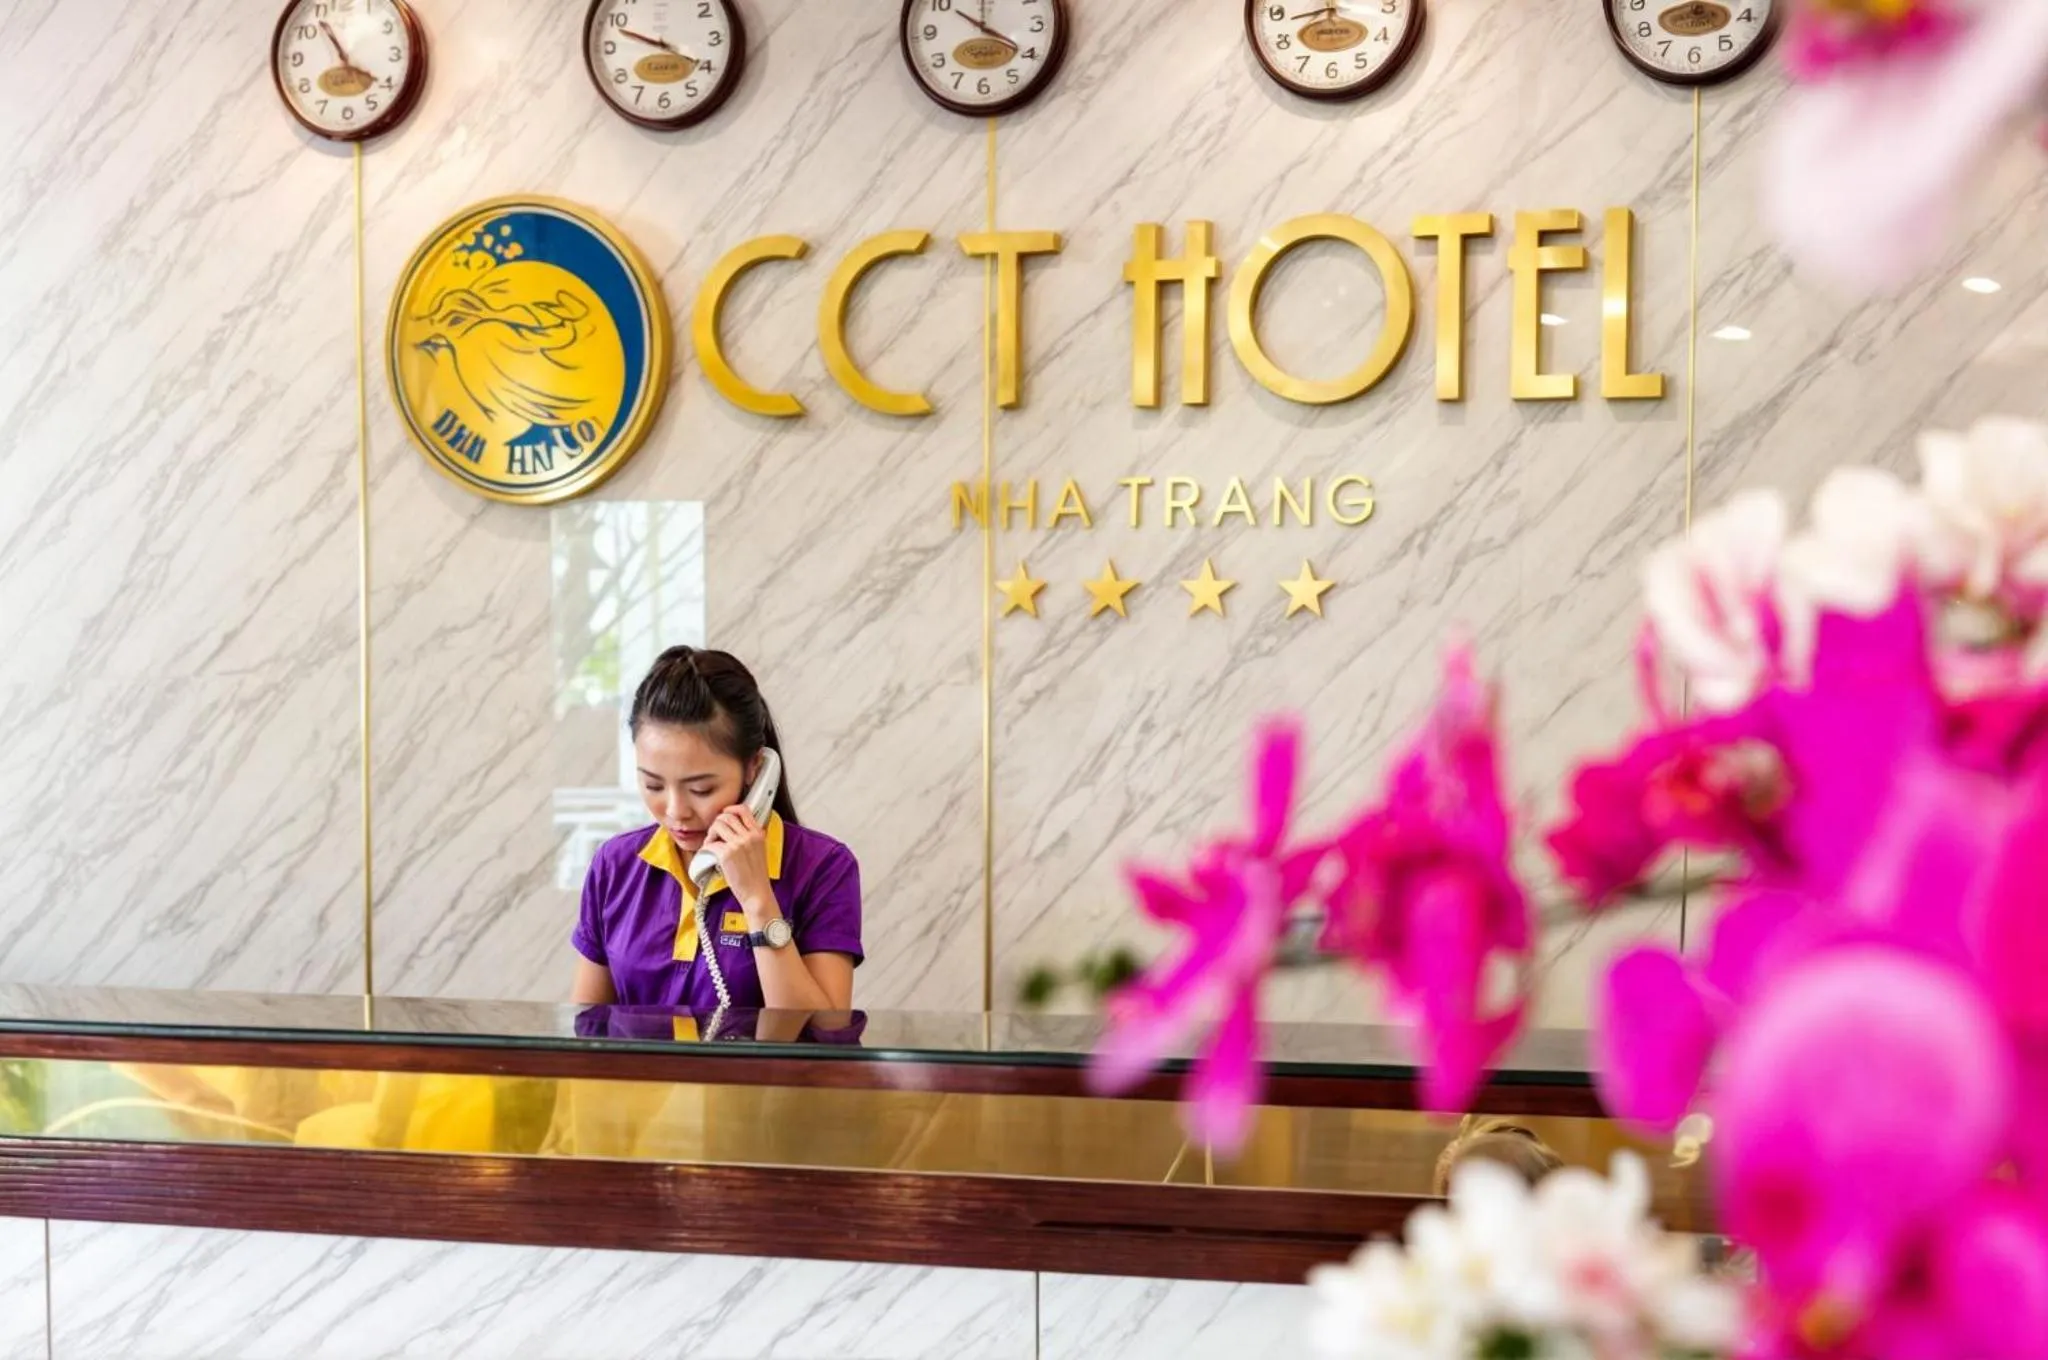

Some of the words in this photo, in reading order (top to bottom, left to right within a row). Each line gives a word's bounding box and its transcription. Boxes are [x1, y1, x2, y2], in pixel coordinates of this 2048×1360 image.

[609, 12, 628, 27] 10
[1736, 8, 1753, 23] 4
[923, 24, 937, 40] 9
[1638, 21, 1652, 37] 8
[1657, 40, 1672, 58] 7
[1687, 46, 1701, 64] 6
[1295, 55, 1311, 73] 7
[1354, 52, 1368, 69] 5
[1006, 69, 1019, 85] 5
[1325, 61, 1338, 79] 6
[685, 80, 698, 97] 5
[950, 72, 964, 90] 7
[977, 77, 991, 95] 6
[631, 85, 645, 105] 7
[657, 91, 671, 109] 6
[691, 229, 1062, 417] CCT
[1123, 207, 1664, 405] HOTEL
[951, 478, 1093, 530] NHA
[1118, 473, 1376, 528] TRANG
